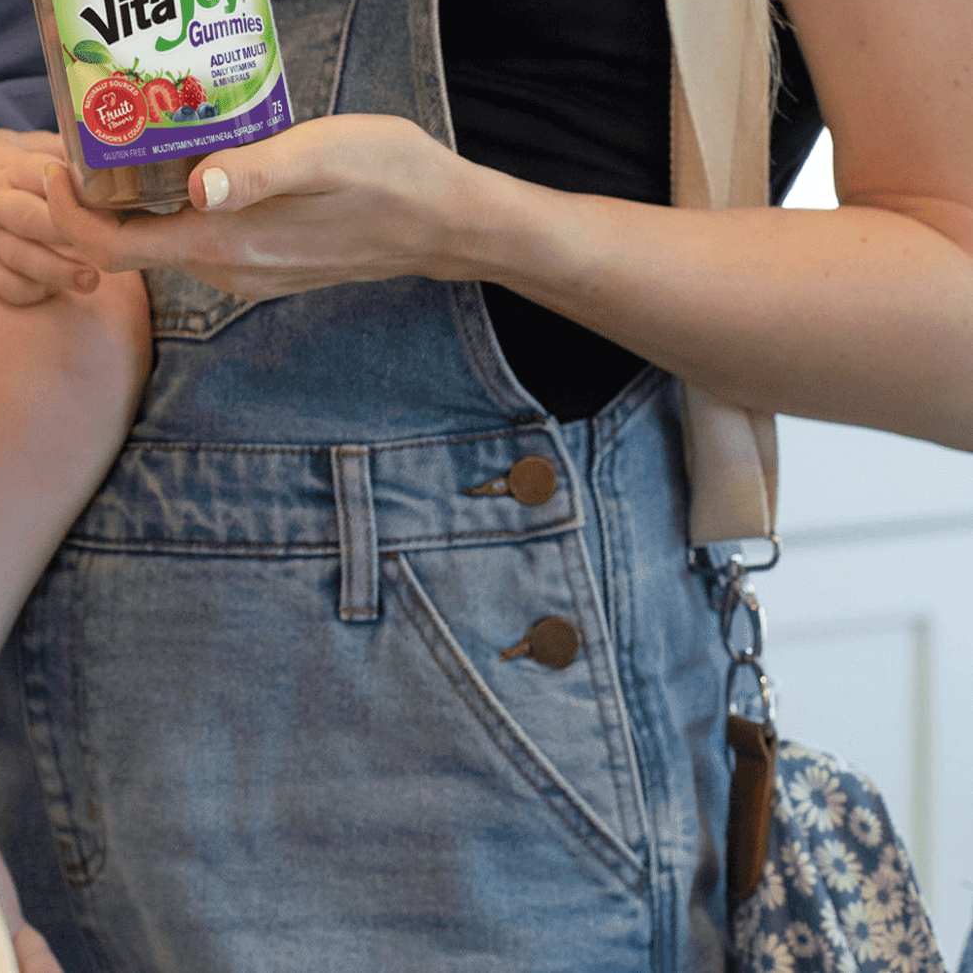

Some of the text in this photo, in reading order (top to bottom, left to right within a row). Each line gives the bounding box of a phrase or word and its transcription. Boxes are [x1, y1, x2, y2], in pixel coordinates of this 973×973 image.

[189, 13, 263, 47] Gummies
[210, 41, 268, 68] ADULT MULTI
[211, 60, 258, 78] DAILY VITAMINS
[219, 71, 251, 86] MINERALS
[84, 79, 139, 109] NATURALLY SOURCED
[271, 99, 283, 115] 75
[95, 100, 134, 125] Fruit
[95, 128, 123, 143] FLAVORS
[128, 116, 146, 139] COLORS
